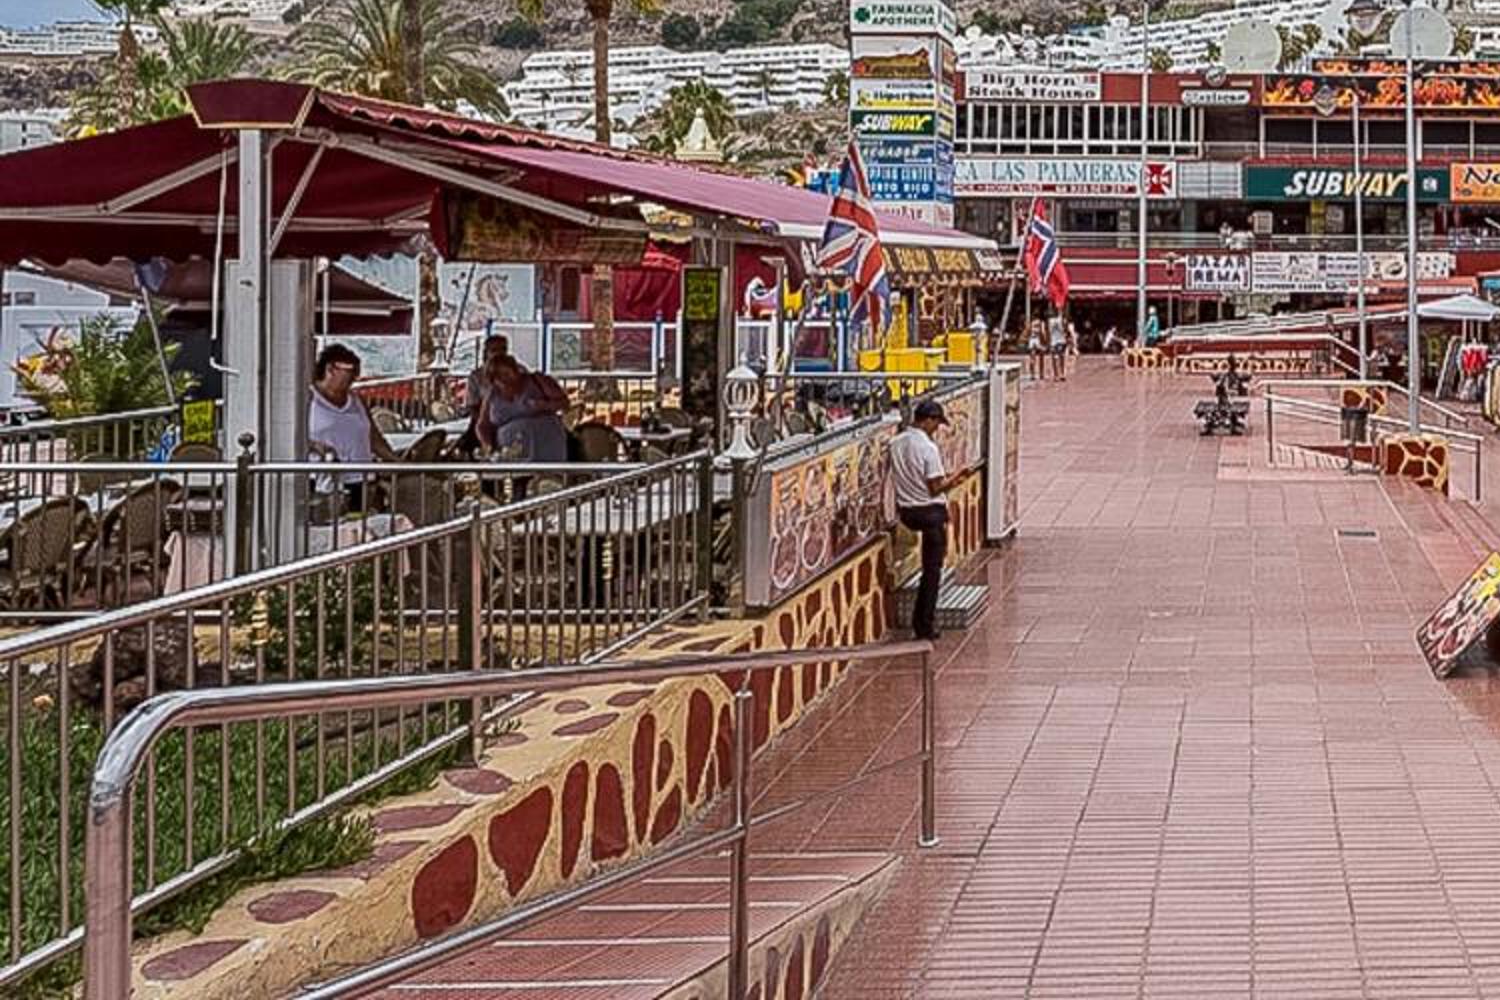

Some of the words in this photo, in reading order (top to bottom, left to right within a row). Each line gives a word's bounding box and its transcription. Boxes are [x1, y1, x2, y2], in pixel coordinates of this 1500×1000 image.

[856, 114, 932, 132] SUBWAY
[991, 161, 1026, 181] LAS
[1037, 161, 1138, 182] PALMERAS
[1284, 170, 1411, 198] SUBWAY
[1188, 253, 1248, 267] BAZAR
